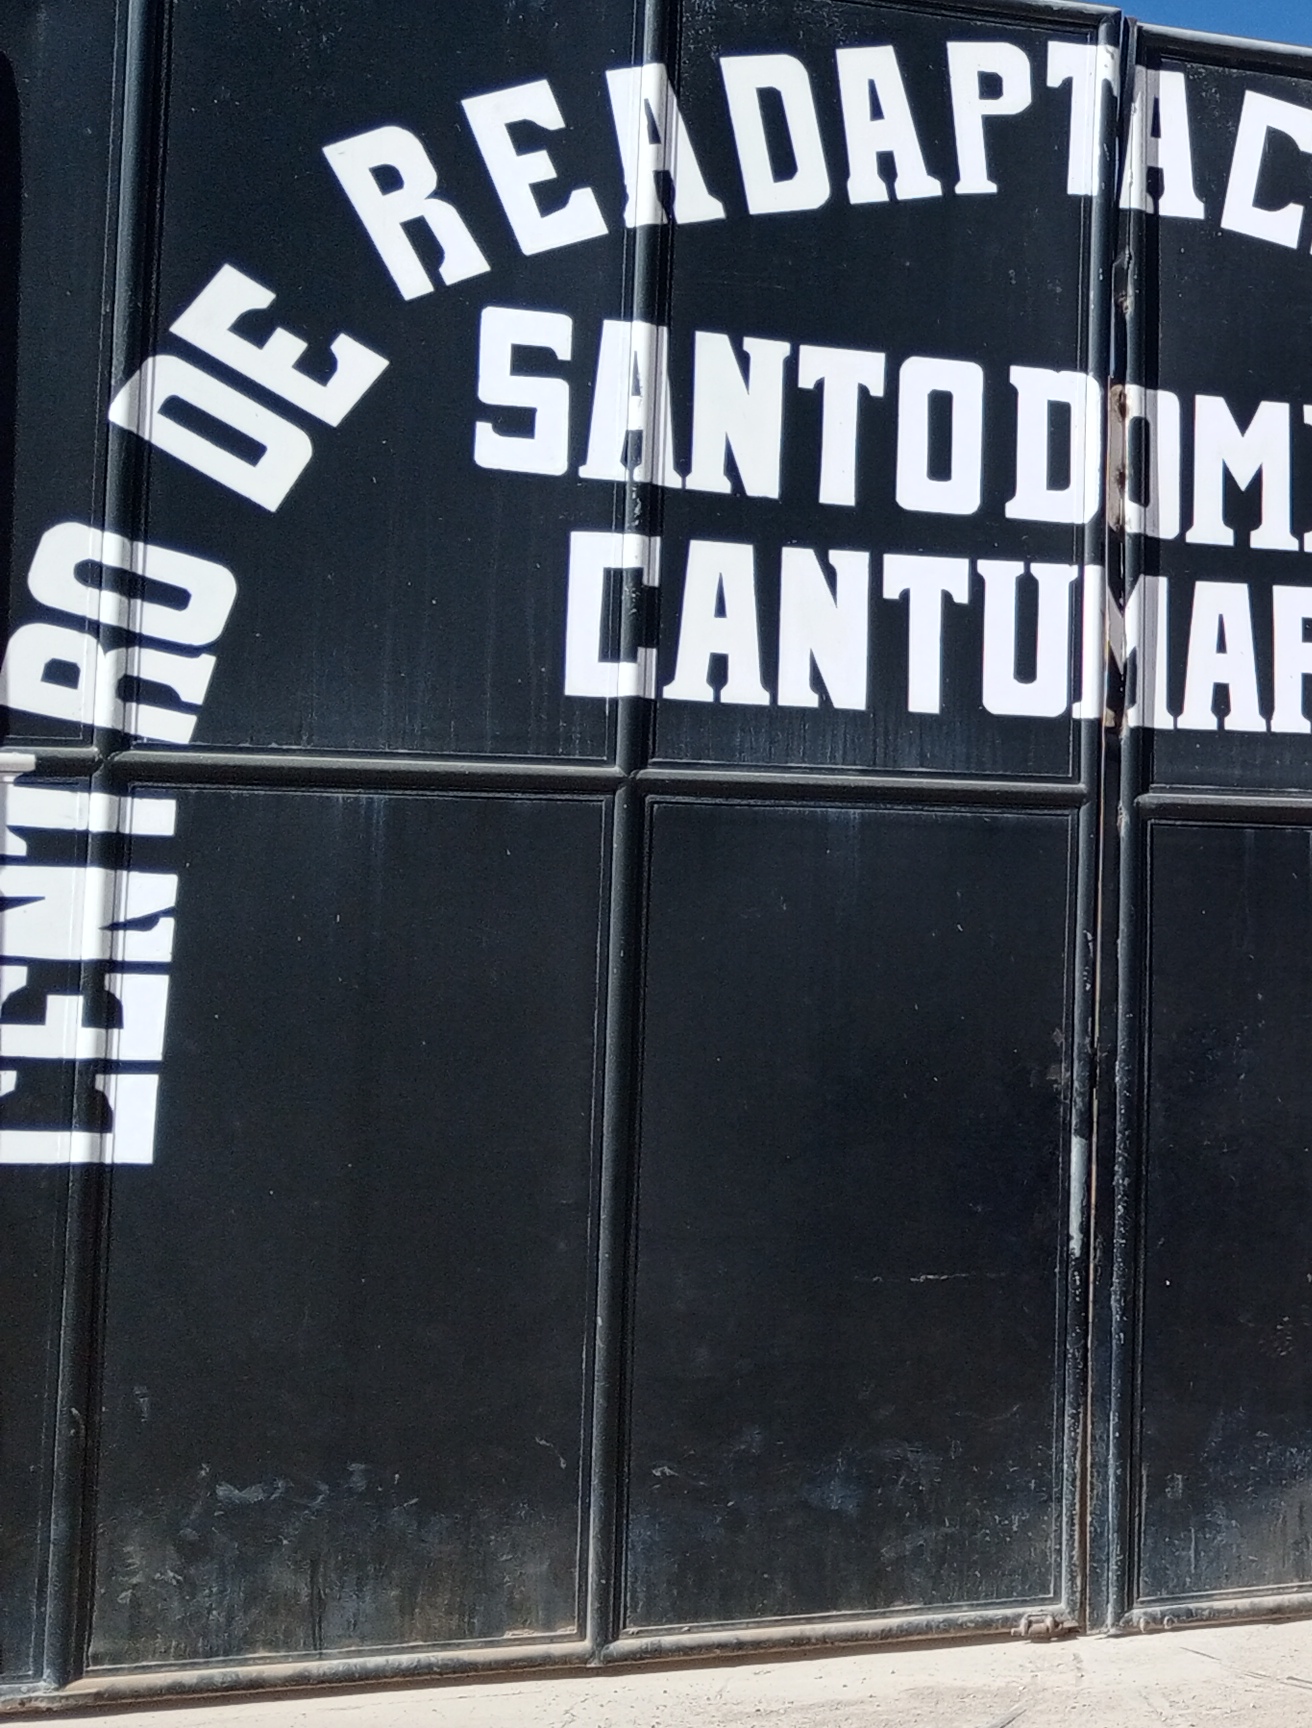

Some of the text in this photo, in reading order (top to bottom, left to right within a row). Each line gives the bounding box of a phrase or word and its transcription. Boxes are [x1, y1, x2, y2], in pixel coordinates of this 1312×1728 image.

[109, 263, 391, 512] DE
[474, 306, 986, 516] SANTO
[0, 522, 237, 1165] CENTRO
